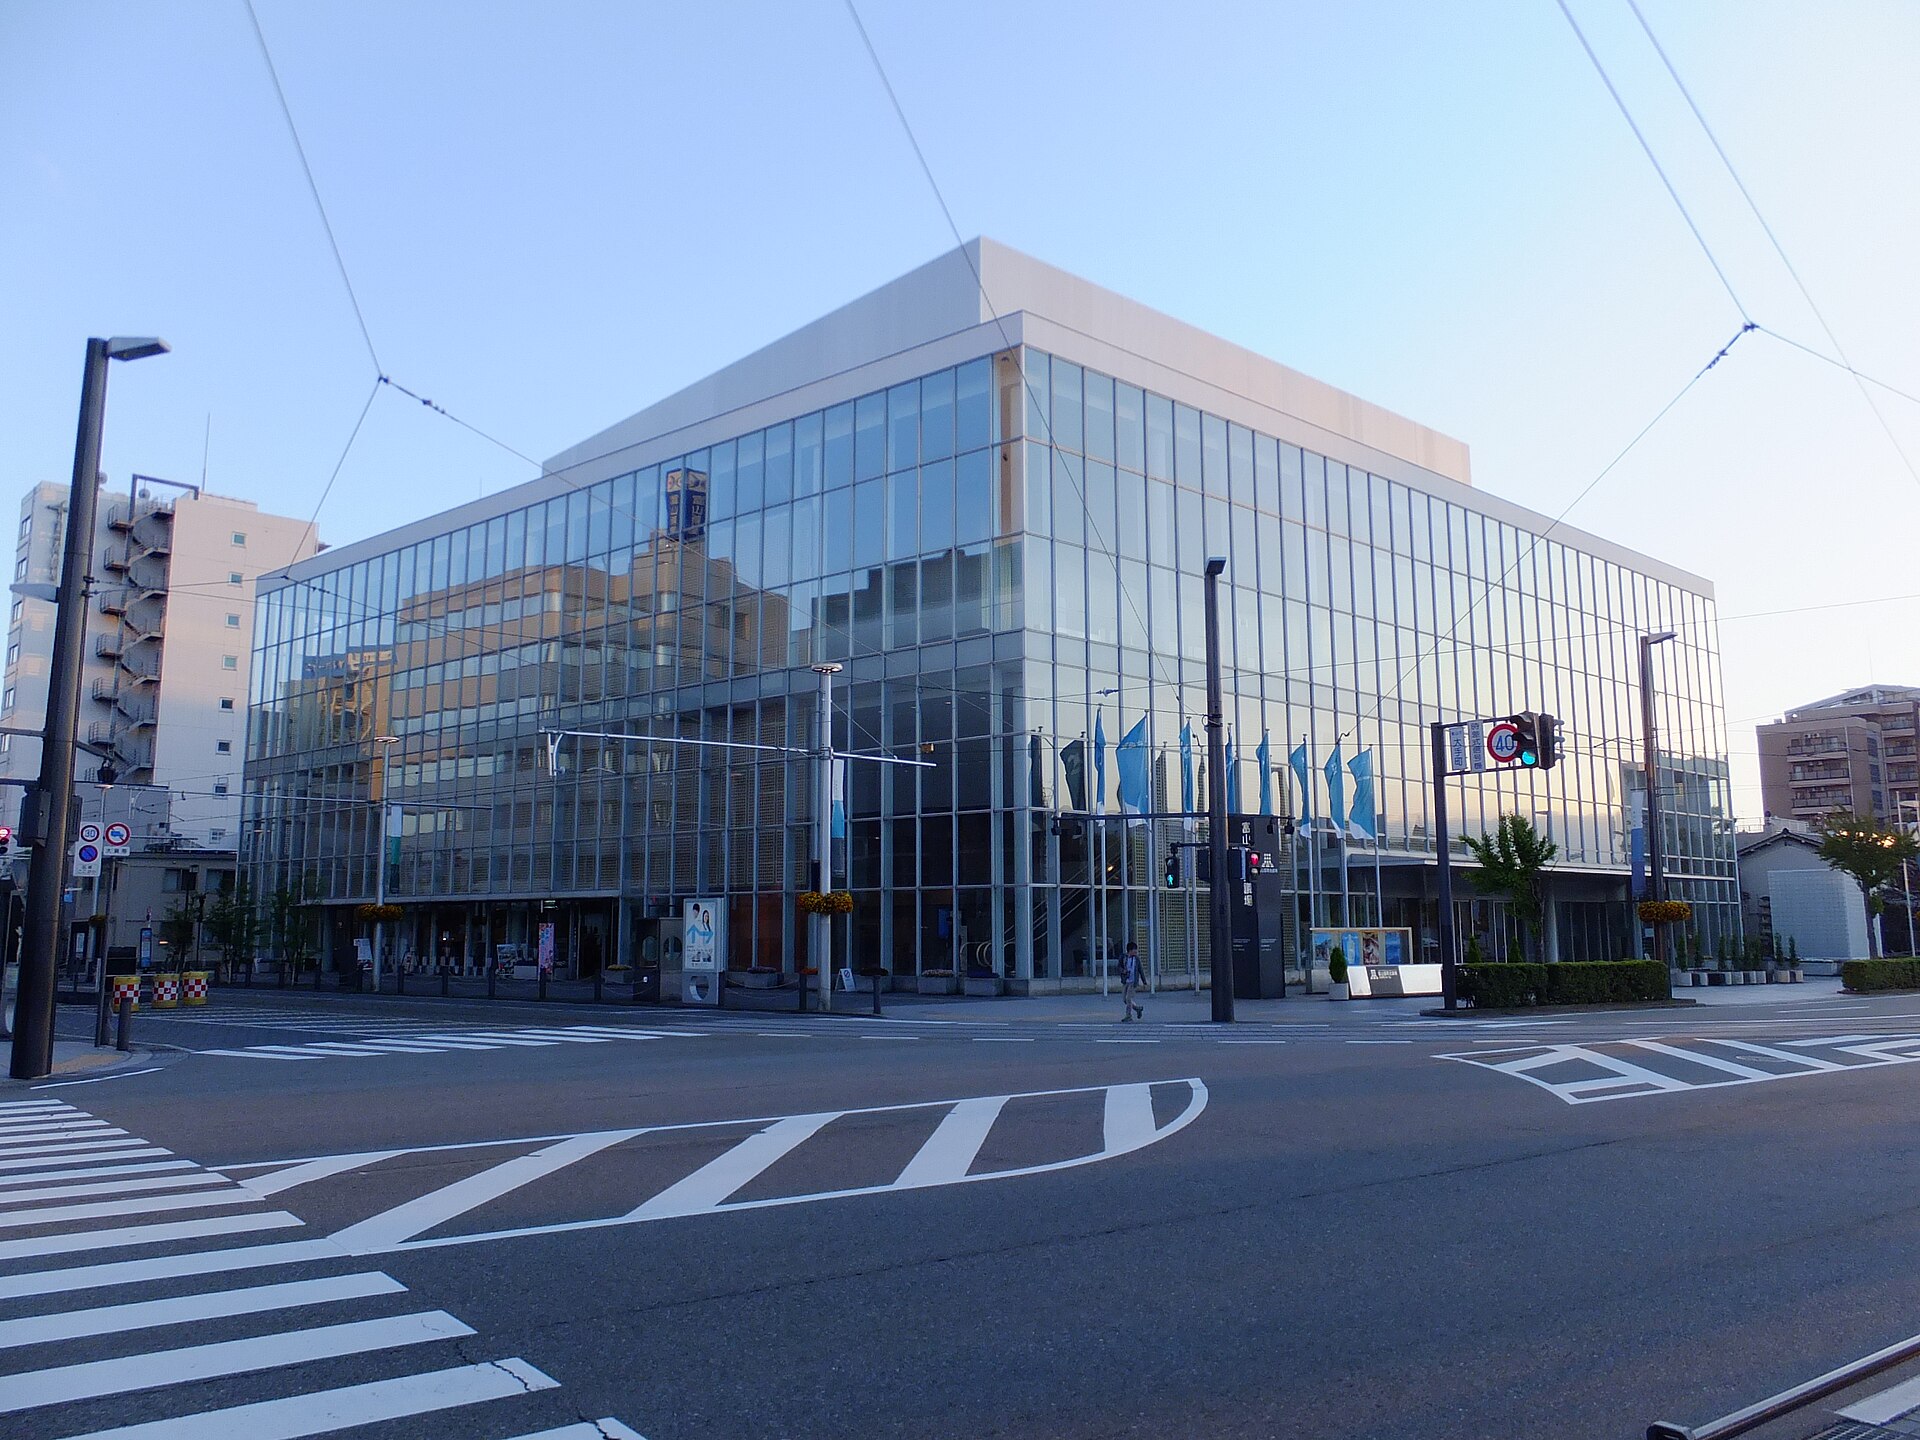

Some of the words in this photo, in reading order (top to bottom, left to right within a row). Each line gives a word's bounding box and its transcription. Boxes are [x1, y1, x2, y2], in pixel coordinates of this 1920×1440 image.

[1495, 735, 1514, 751] 40
[1453, 738, 1463, 766] 大手町
[85, 829, 96, 838] 30
